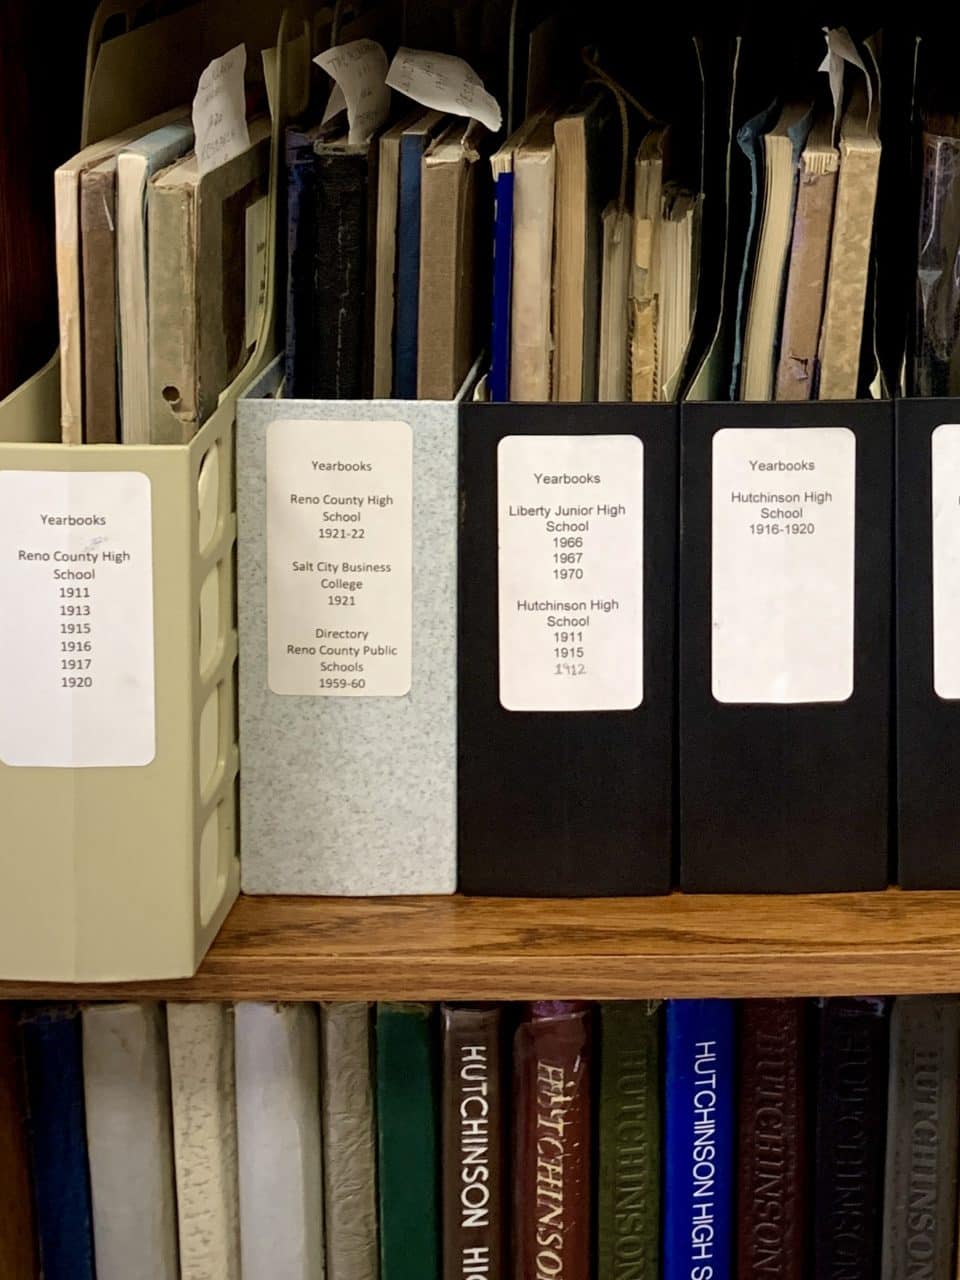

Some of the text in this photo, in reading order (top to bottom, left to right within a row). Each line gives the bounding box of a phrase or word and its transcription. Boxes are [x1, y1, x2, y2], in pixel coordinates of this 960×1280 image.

[312, 461, 372, 471] Yearbooks
[749, 460, 815, 471] Yearbooks
[534, 473, 600, 484] Yearbooks
[291, 494, 393, 507] Reno County High
[732, 492, 832, 504] Hutchinson High
[509, 504, 625, 518] Liberty Junior High
[761, 508, 802, 519] School
[41, 515, 106, 526] Yearbooks
[323, 512, 360, 522] School
[546, 521, 589, 532] School
[750, 523, 815, 535] 1916-1920
[320, 529, 364, 539] 1921-22
[554, 537, 583, 548] 1966
[19, 550, 130, 564] Reno County High
[554, 553, 583, 563] 1967
[293, 561, 391, 574] Salt City Business
[54, 569, 95, 580] School
[554, 569, 583, 579] 1970
[321, 579, 363, 591] College
[60, 588, 90, 598] 1911
[329, 596, 355, 606] 1921
[517, 600, 619, 612] Hutchinson High
[61, 605, 90, 616] 1913
[547, 616, 589, 627] School
[61, 623, 91, 634] 1915
[555, 632, 582, 642] 1911
[62, 641, 91, 652] 1916
[554, 647, 584, 658] 1915
[62, 659, 91, 670] 1917
[554, 663, 586, 676] 1912
[62, 677, 92, 688] 1920
[460, 1047, 488, 1227] HUTCHINSON
[691, 1041, 716, 1259] HUTCHINSON HIGH
